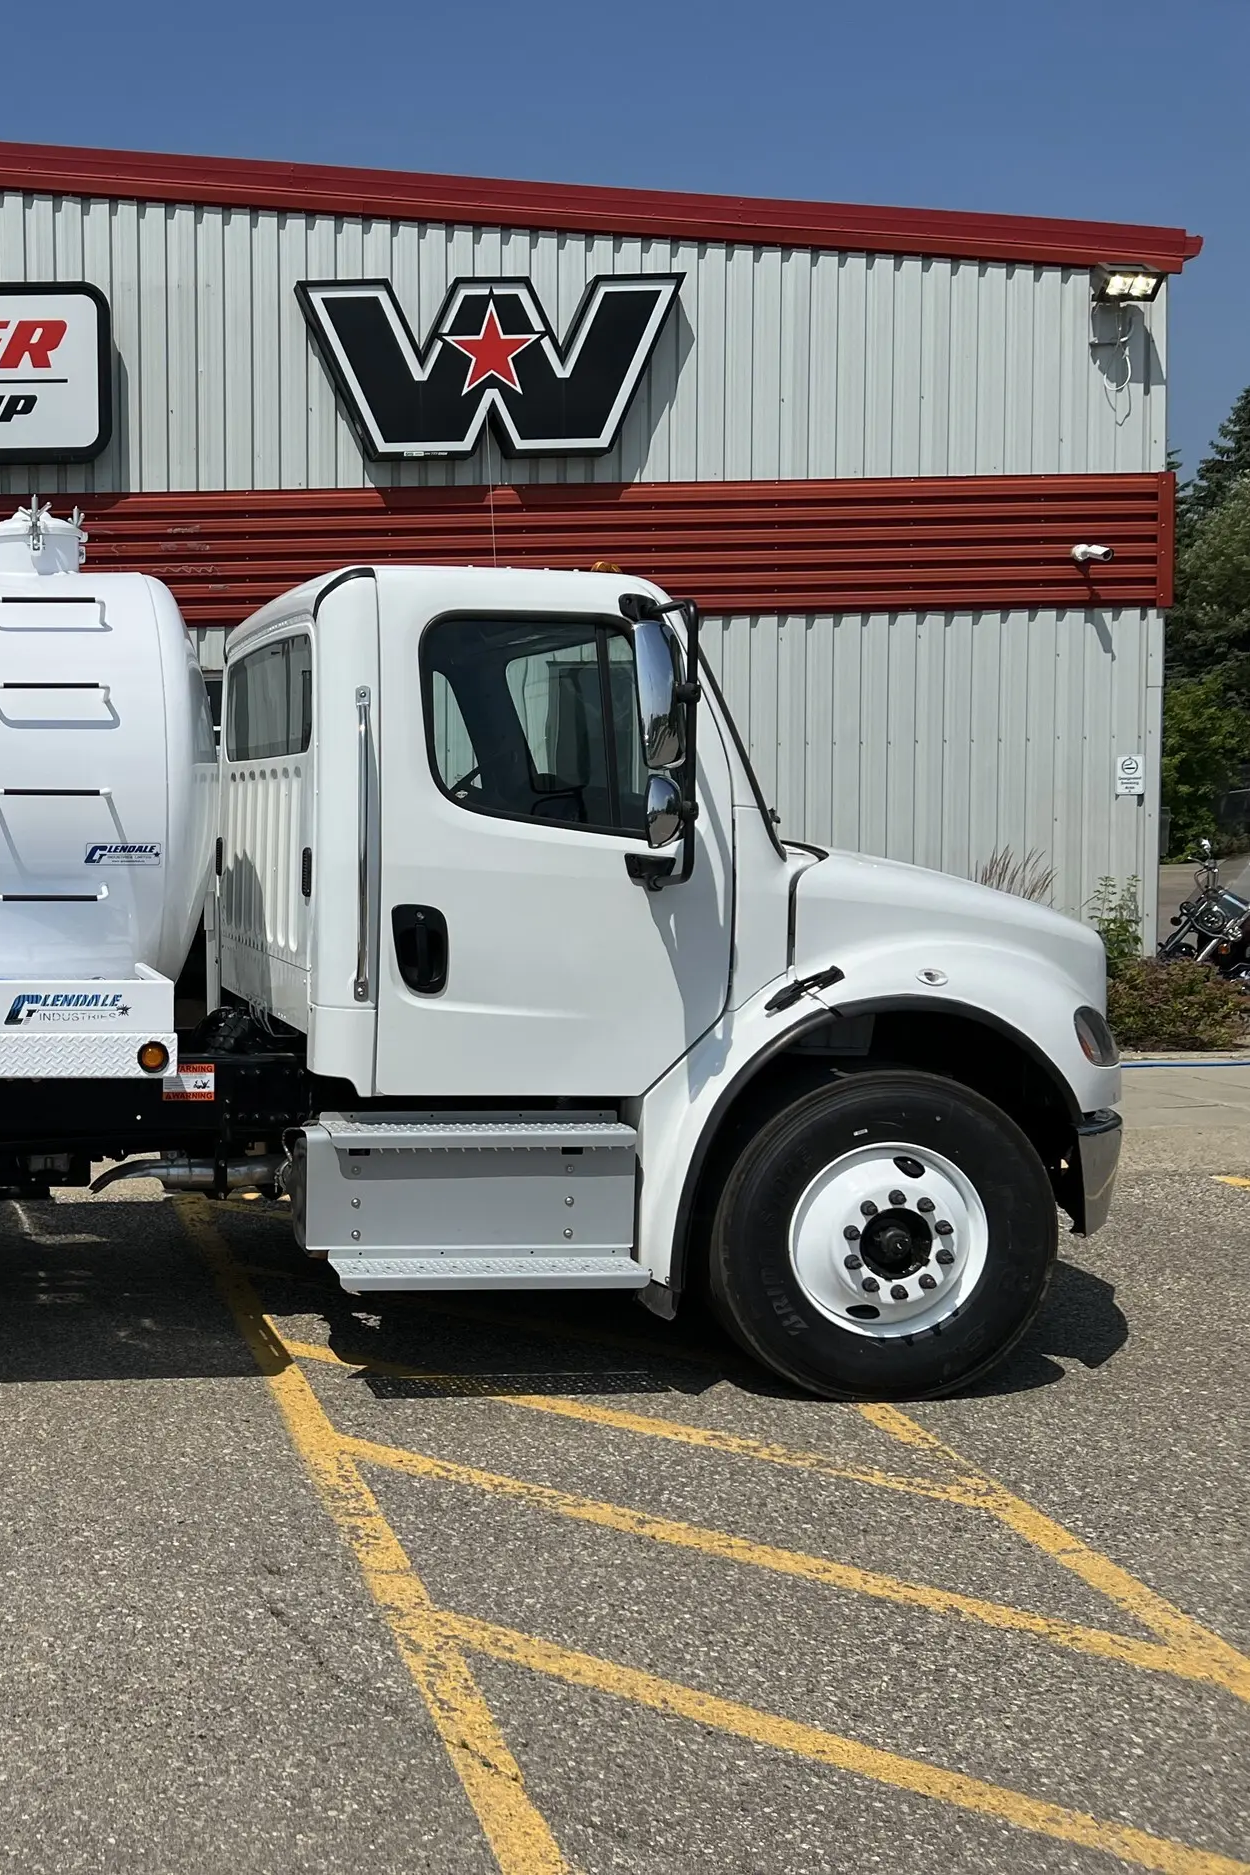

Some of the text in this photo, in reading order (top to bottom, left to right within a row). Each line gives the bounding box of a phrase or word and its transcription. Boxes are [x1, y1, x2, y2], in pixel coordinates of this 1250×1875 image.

[84, 845, 156, 863] GLENDALE
[4, 994, 122, 1025] GLENDALE
[39, 1012, 116, 1022] INDUSTRIES
